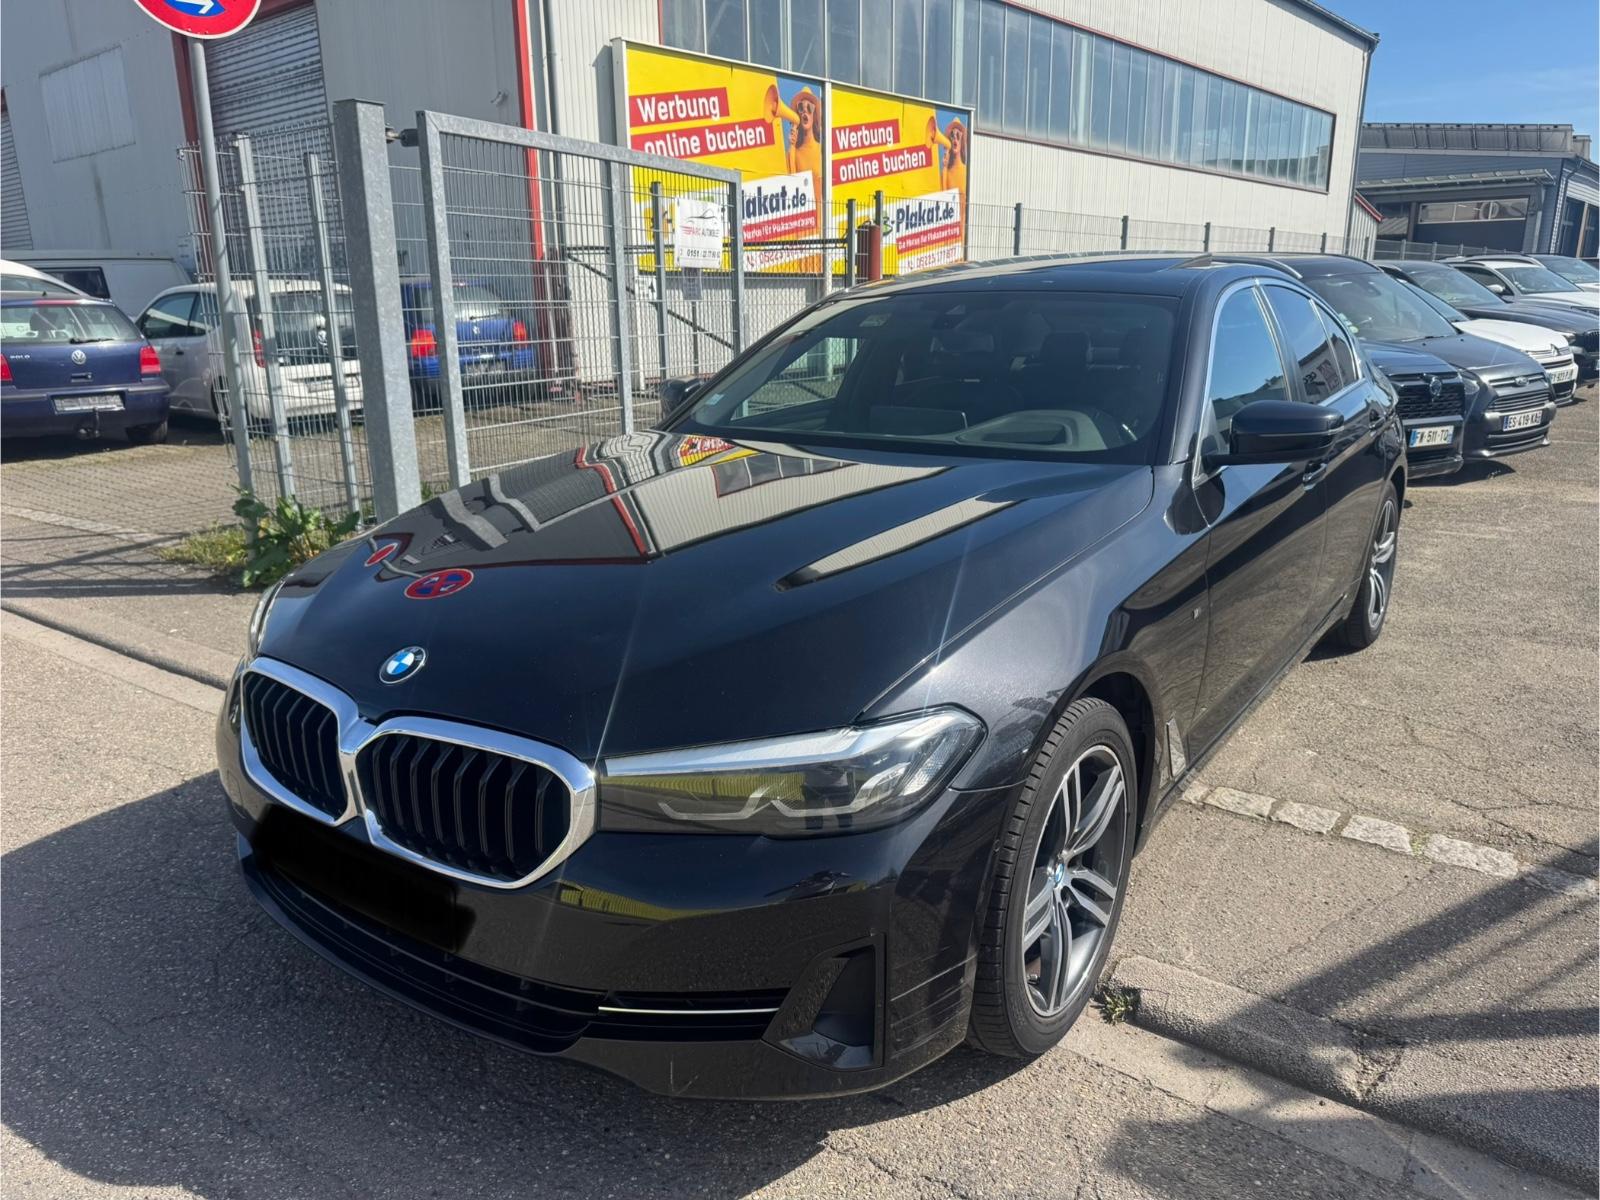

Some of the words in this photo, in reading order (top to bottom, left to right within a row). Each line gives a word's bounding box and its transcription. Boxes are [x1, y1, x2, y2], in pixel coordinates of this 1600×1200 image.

[636, 95, 720, 122] Werbung
[644, 132, 700, 158] online
[705, 124, 766, 152] buchen
[836, 125, 894, 149] Werbung
[840, 157, 879, 181] online
[882, 148, 926, 173] buchen
[741, 186, 807, 219] lakat.de
